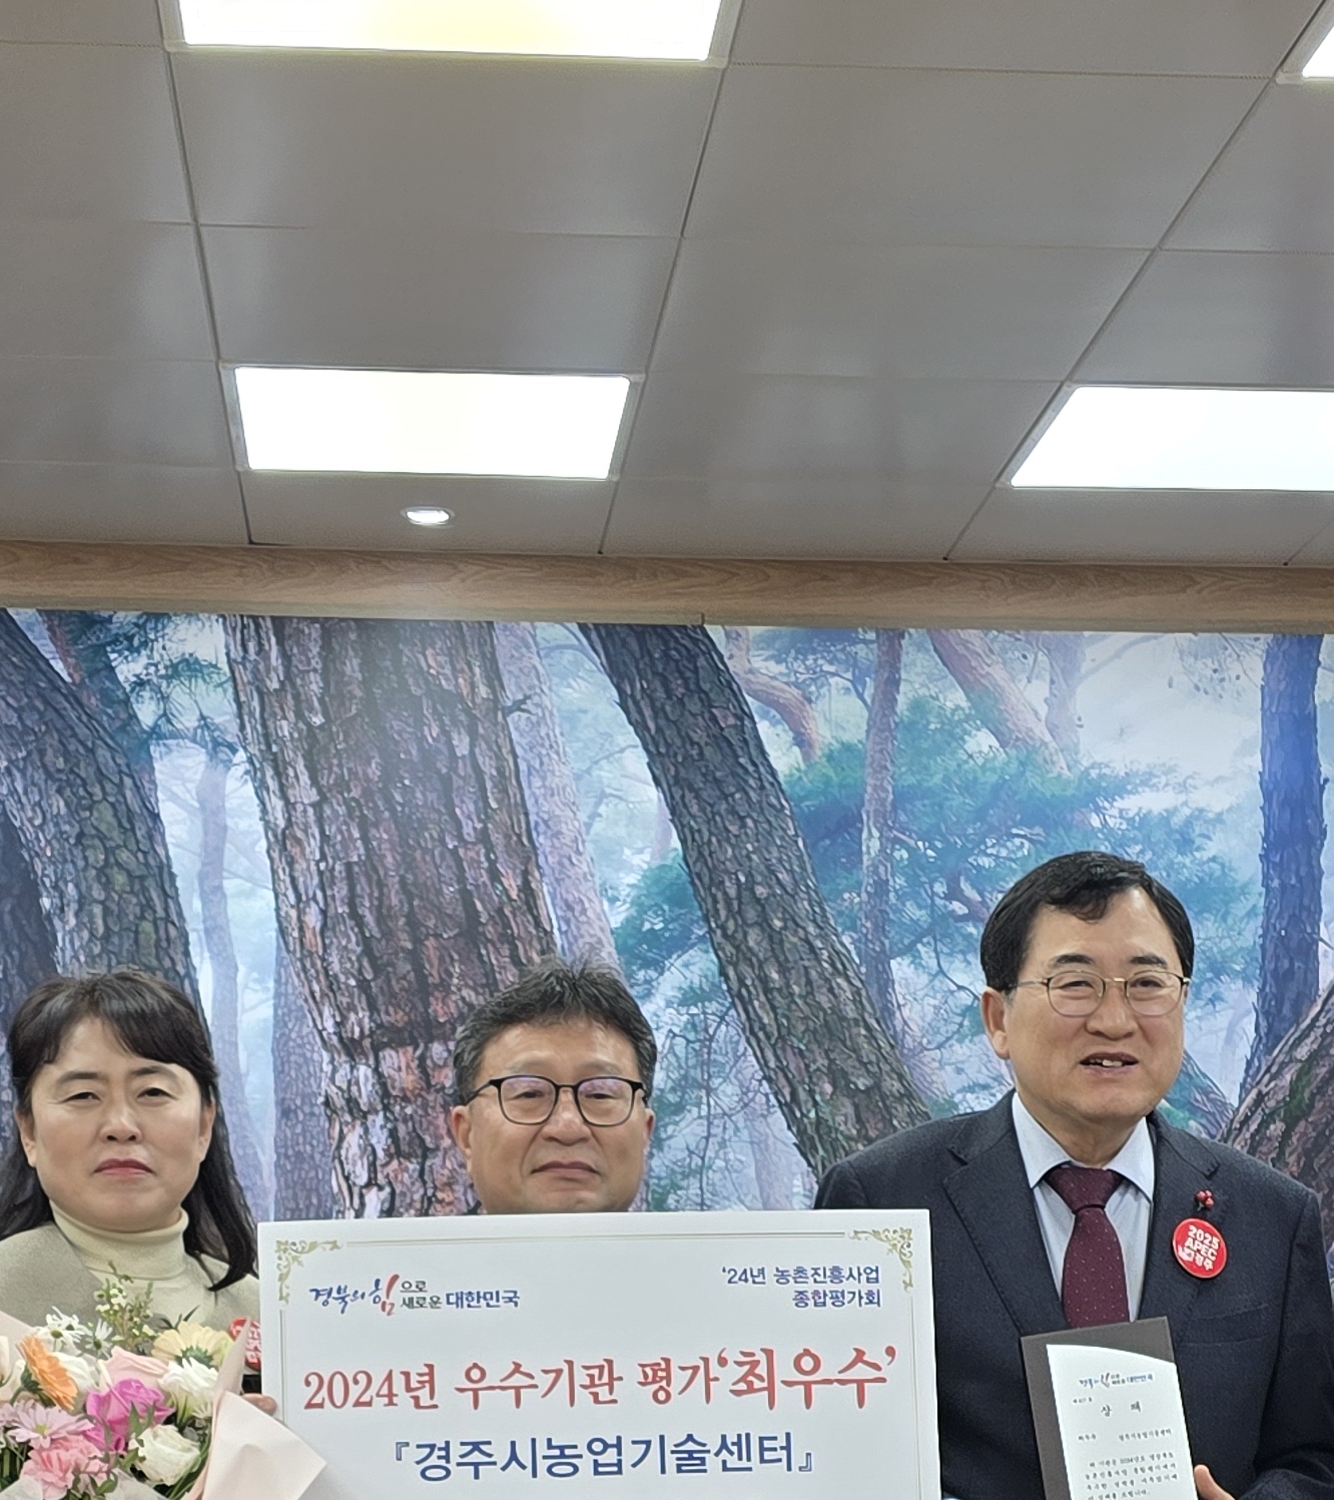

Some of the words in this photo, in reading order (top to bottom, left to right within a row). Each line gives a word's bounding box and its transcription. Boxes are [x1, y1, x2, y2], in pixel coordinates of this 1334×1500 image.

[1188, 1225, 1219, 1249] 2025
[1185, 1237, 1217, 1261] APEC
[774, 1266, 879, 1285] 농촌진흥사업
[401, 1281, 426, 1292] 으로
[310, 1285, 365, 1314] 경북의
[403, 1296, 441, 1309] 새로운
[446, 1290, 520, 1308] 대한민국
[793, 1289, 880, 1308] 종합평가회
[304, 1364, 438, 1409] 2024년
[455, 1359, 623, 1410] 우수기관
[396, 1432, 812, 1481] 『경주시농업기술센터』
